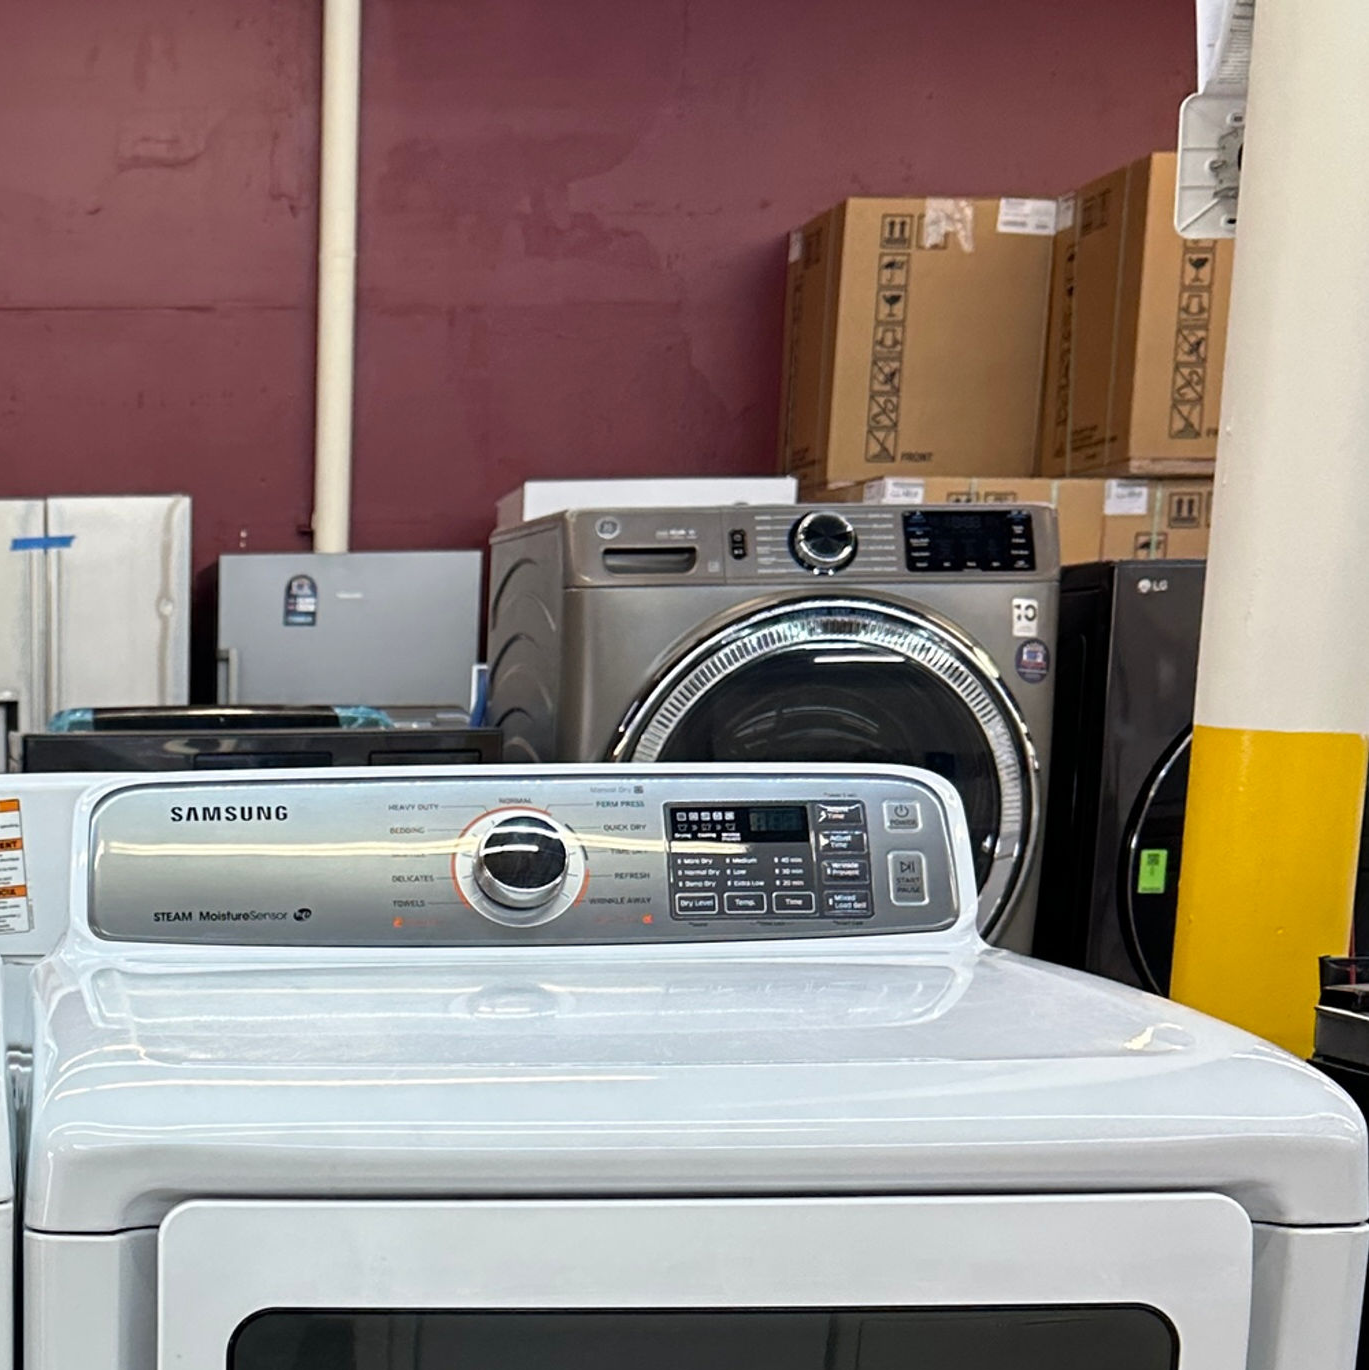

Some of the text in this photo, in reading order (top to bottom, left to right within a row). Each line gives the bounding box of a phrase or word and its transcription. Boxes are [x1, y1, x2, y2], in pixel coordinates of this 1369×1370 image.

[388, 803, 439, 811] HEAVY DUTY
[595, 800, 645, 808] PERM PRESS
[170, 805, 288, 822] SAMSUNG
[389, 826, 426, 834] BEDDING
[603, 823, 647, 832] QUICK DRY
[391, 874, 435, 883] DELICATES
[613, 871, 651, 880] REFRESH
[392, 900, 426, 908] TOWELS
[625, 896, 652, 905] AWAY
[680, 899, 714, 908] Dry Level
[784, 898, 803, 906] Time
[153, 910, 288, 922] STEAM MoistureSensor
